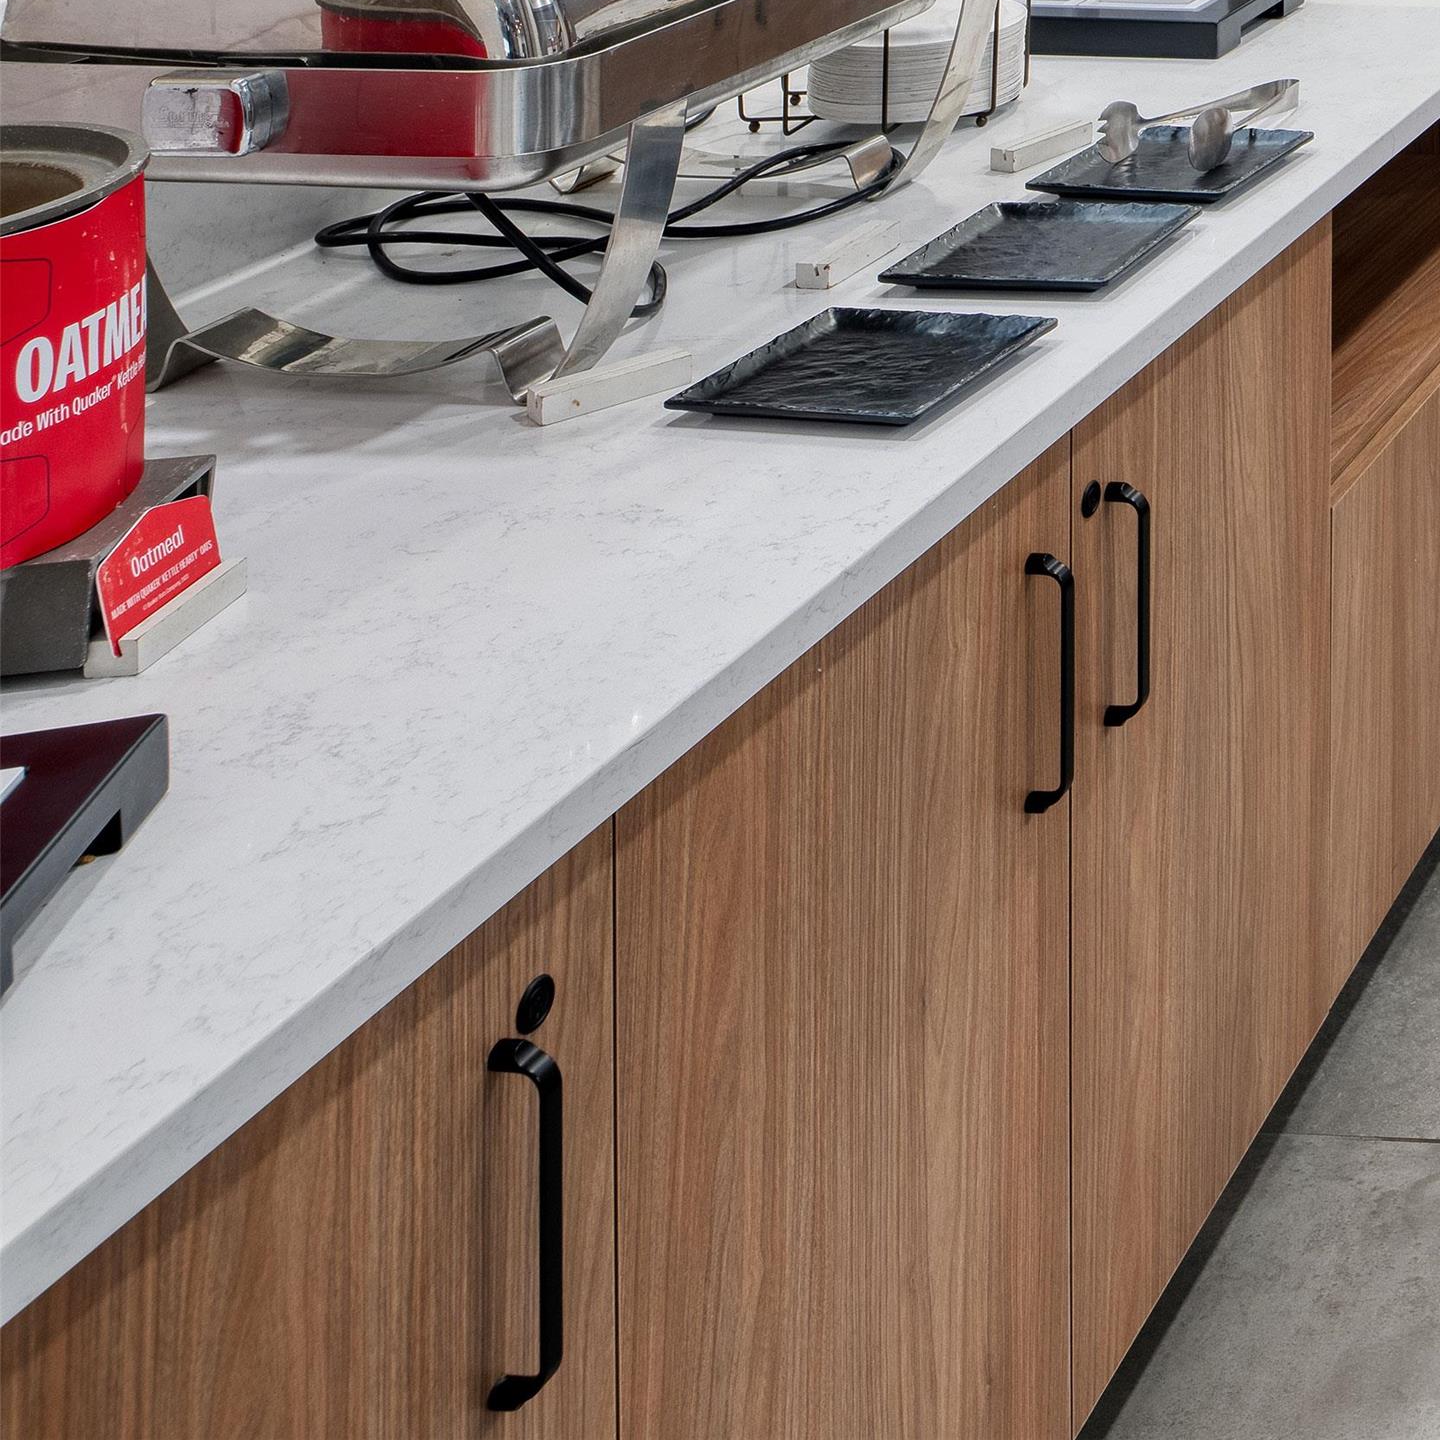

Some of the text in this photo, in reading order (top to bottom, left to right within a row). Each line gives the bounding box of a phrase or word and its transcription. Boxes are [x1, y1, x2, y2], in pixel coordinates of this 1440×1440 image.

[15, 273, 147, 404] OATMEA
[0, 420, 33, 447] ade
[36, 403, 70, 432] With
[130, 524, 185, 578] Oatmeal
